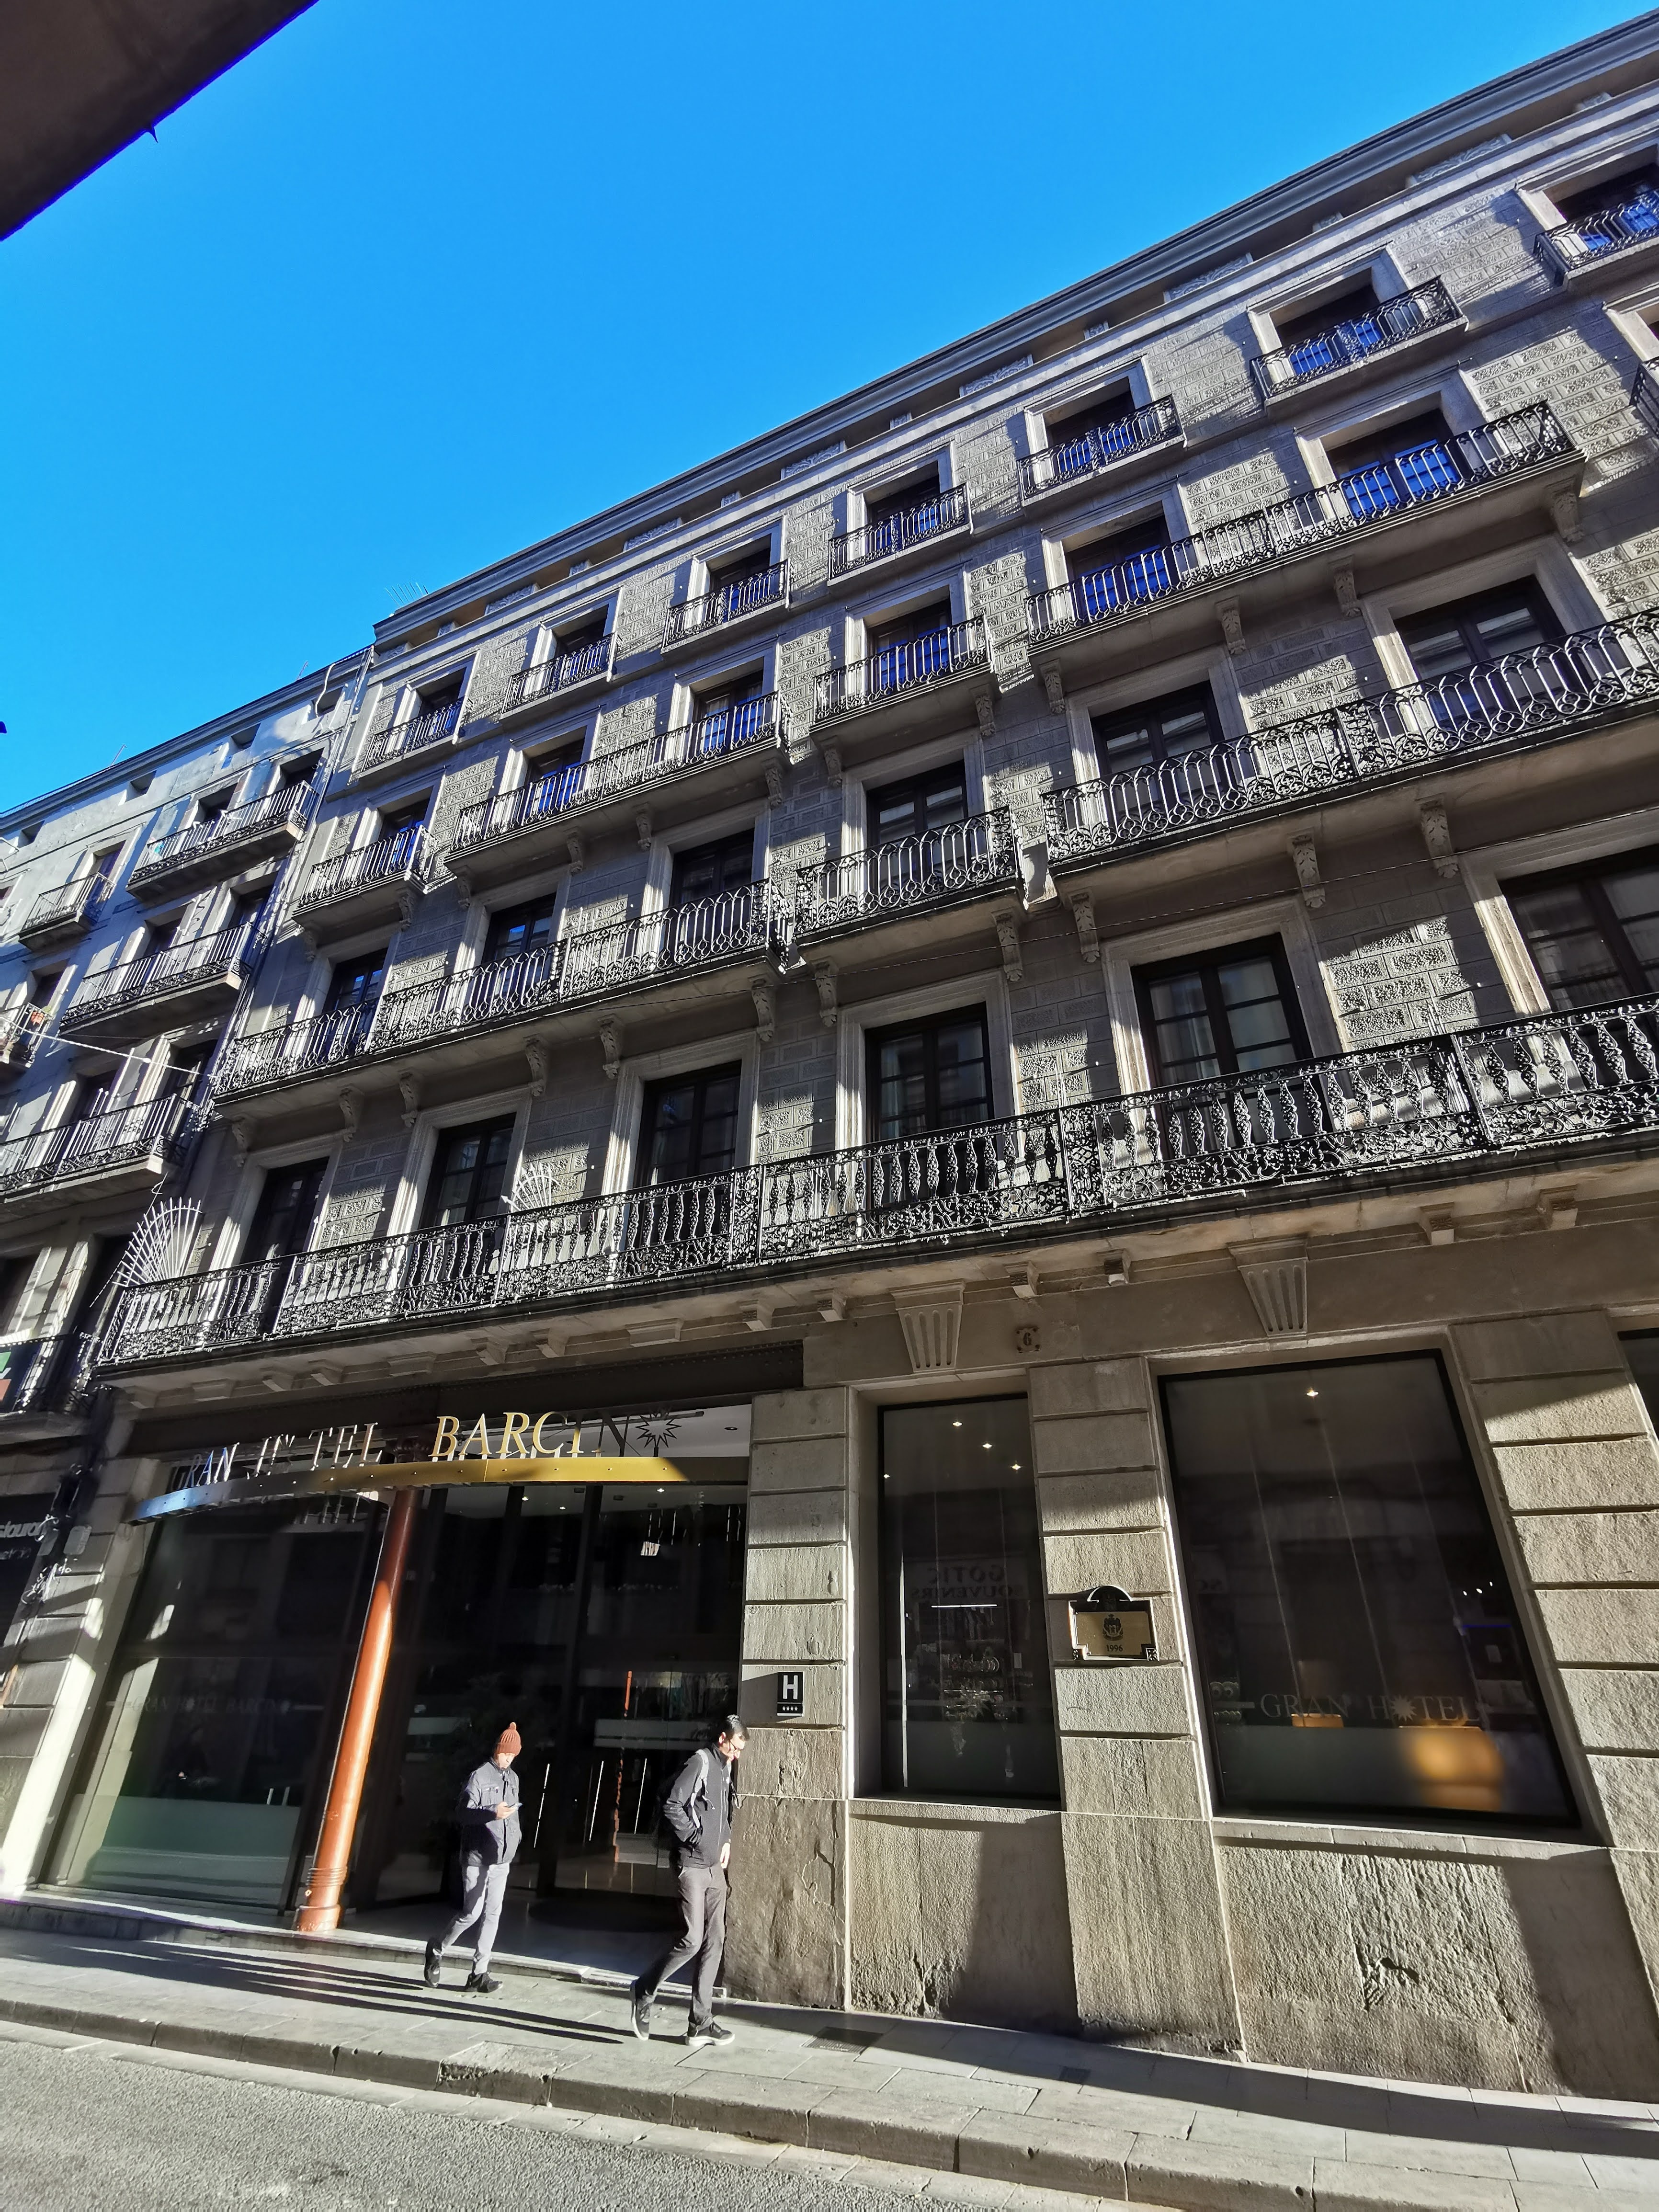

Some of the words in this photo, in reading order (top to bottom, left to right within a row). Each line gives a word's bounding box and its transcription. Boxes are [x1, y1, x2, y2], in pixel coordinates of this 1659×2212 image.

[252, 1422, 383, 1473] HTEL
[1106, 1644, 1123, 1652] 1996
[783, 1675, 798, 1699] H
[1260, 1693, 1349, 1719] GRAN
